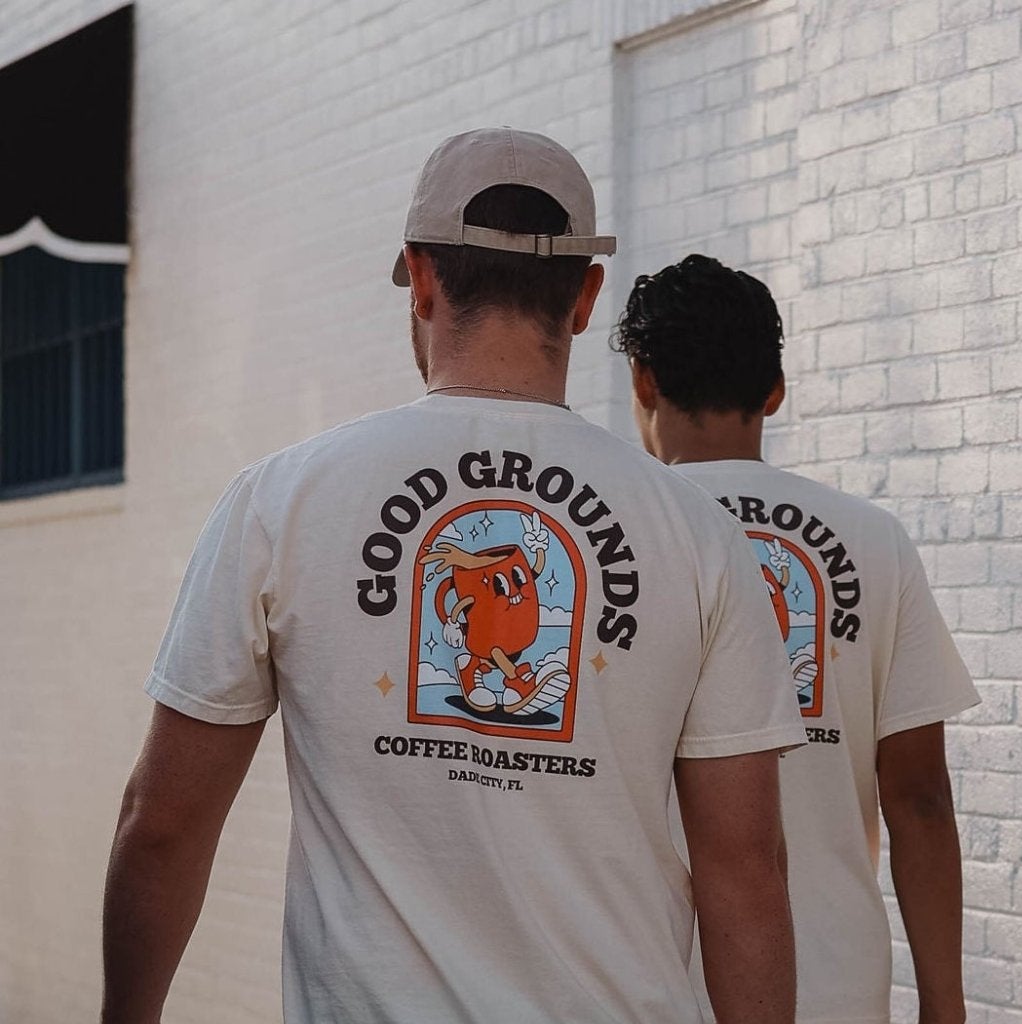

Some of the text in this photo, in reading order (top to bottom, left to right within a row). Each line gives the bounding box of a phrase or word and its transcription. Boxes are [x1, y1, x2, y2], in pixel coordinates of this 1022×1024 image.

[357, 450, 640, 651] GOOD GROUNDS
[374, 735, 597, 777] COFFEE ROASTERS
[480, 775, 506, 791] CITY,
[507, 779, 524, 791] FL
